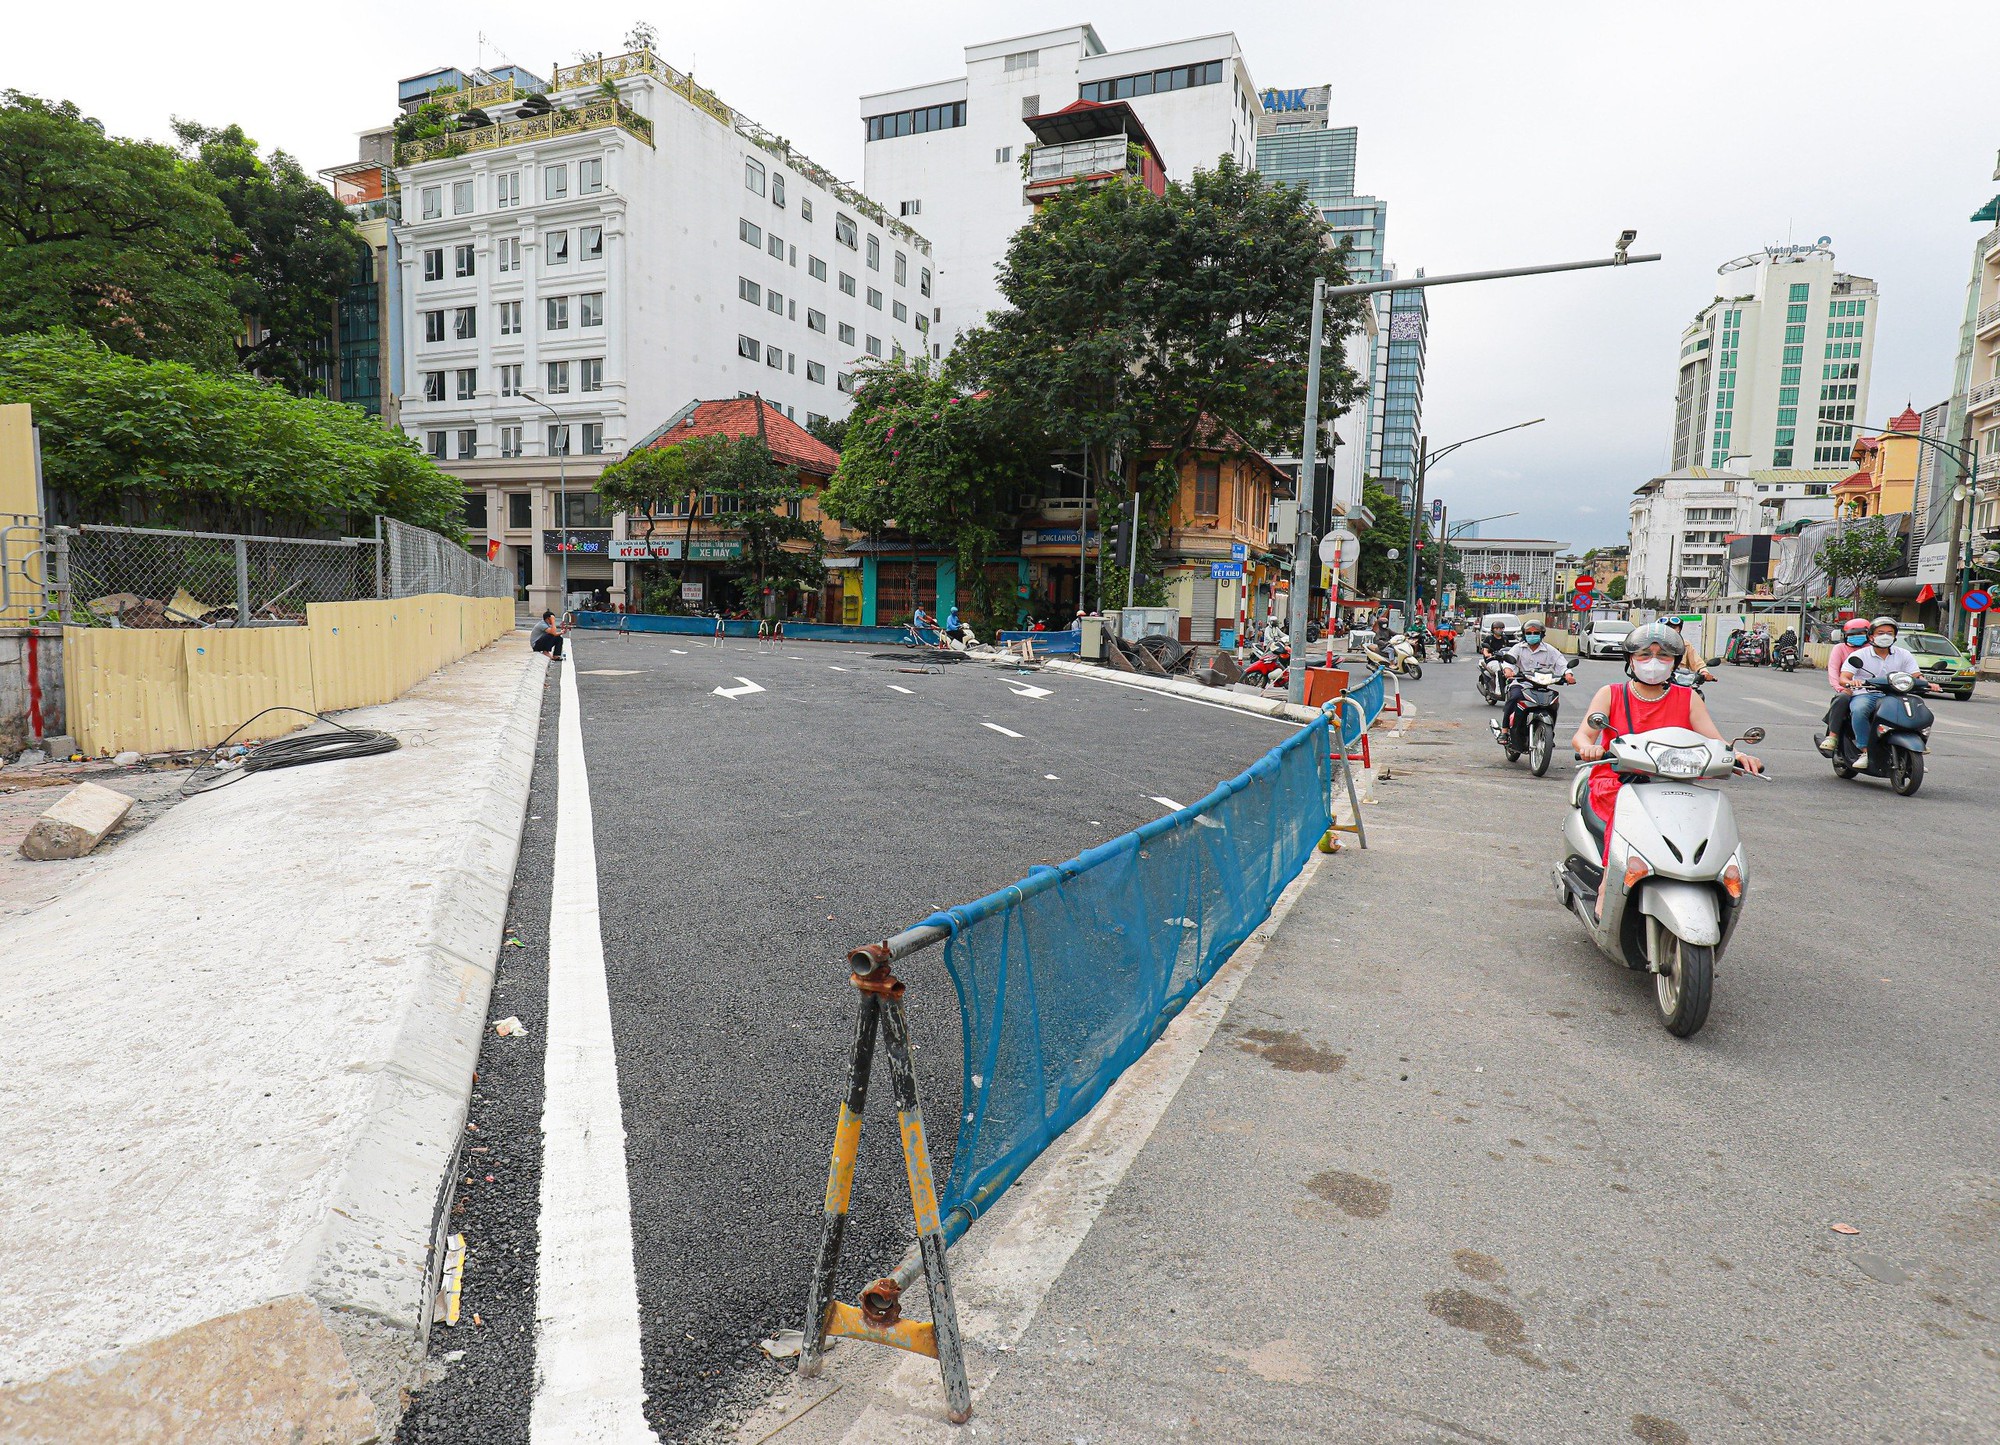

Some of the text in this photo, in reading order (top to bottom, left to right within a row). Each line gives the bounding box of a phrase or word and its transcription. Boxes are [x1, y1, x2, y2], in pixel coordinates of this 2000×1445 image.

[1258, 88, 1307, 111] ANK
[633, 547, 646, 556] SƯ
[700, 548, 731, 557] XE MÁY
